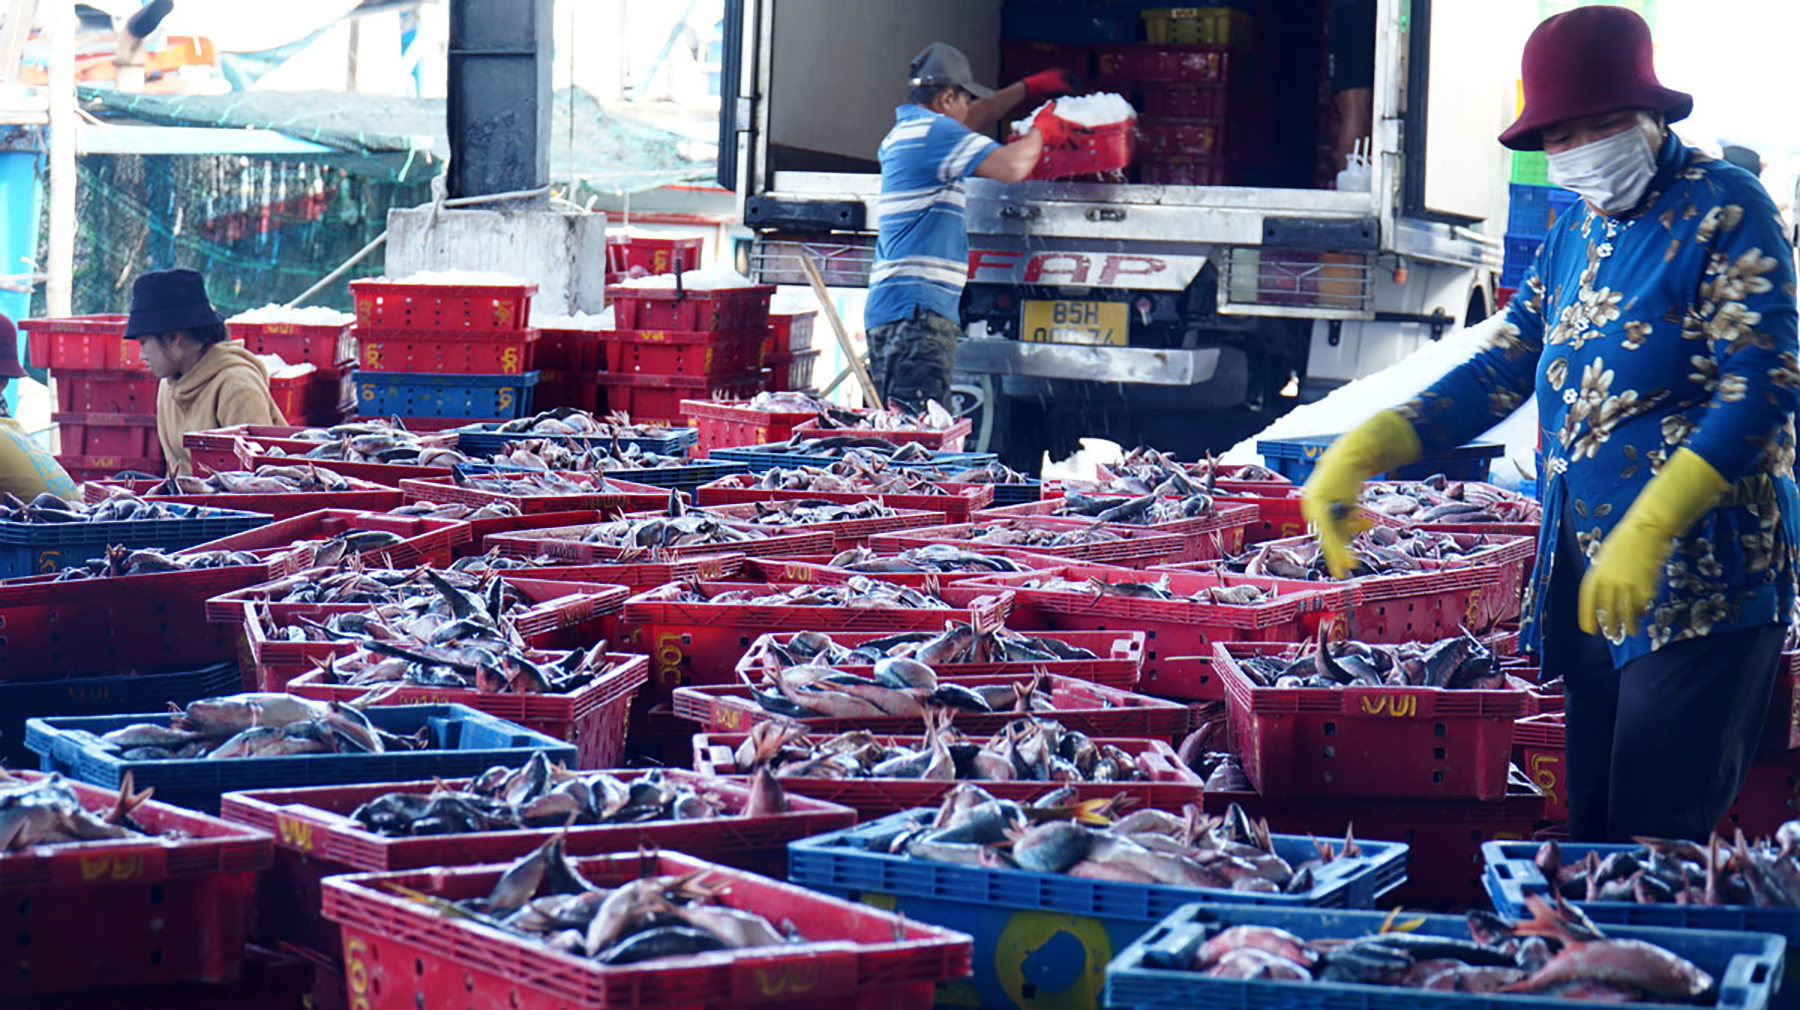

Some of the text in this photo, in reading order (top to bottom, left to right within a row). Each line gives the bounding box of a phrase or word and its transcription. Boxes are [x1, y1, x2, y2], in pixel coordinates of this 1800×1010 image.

[966, 250, 1166, 285] FAP
[1053, 303, 1098, 325] 85H
[1362, 694, 1417, 717] VUI
